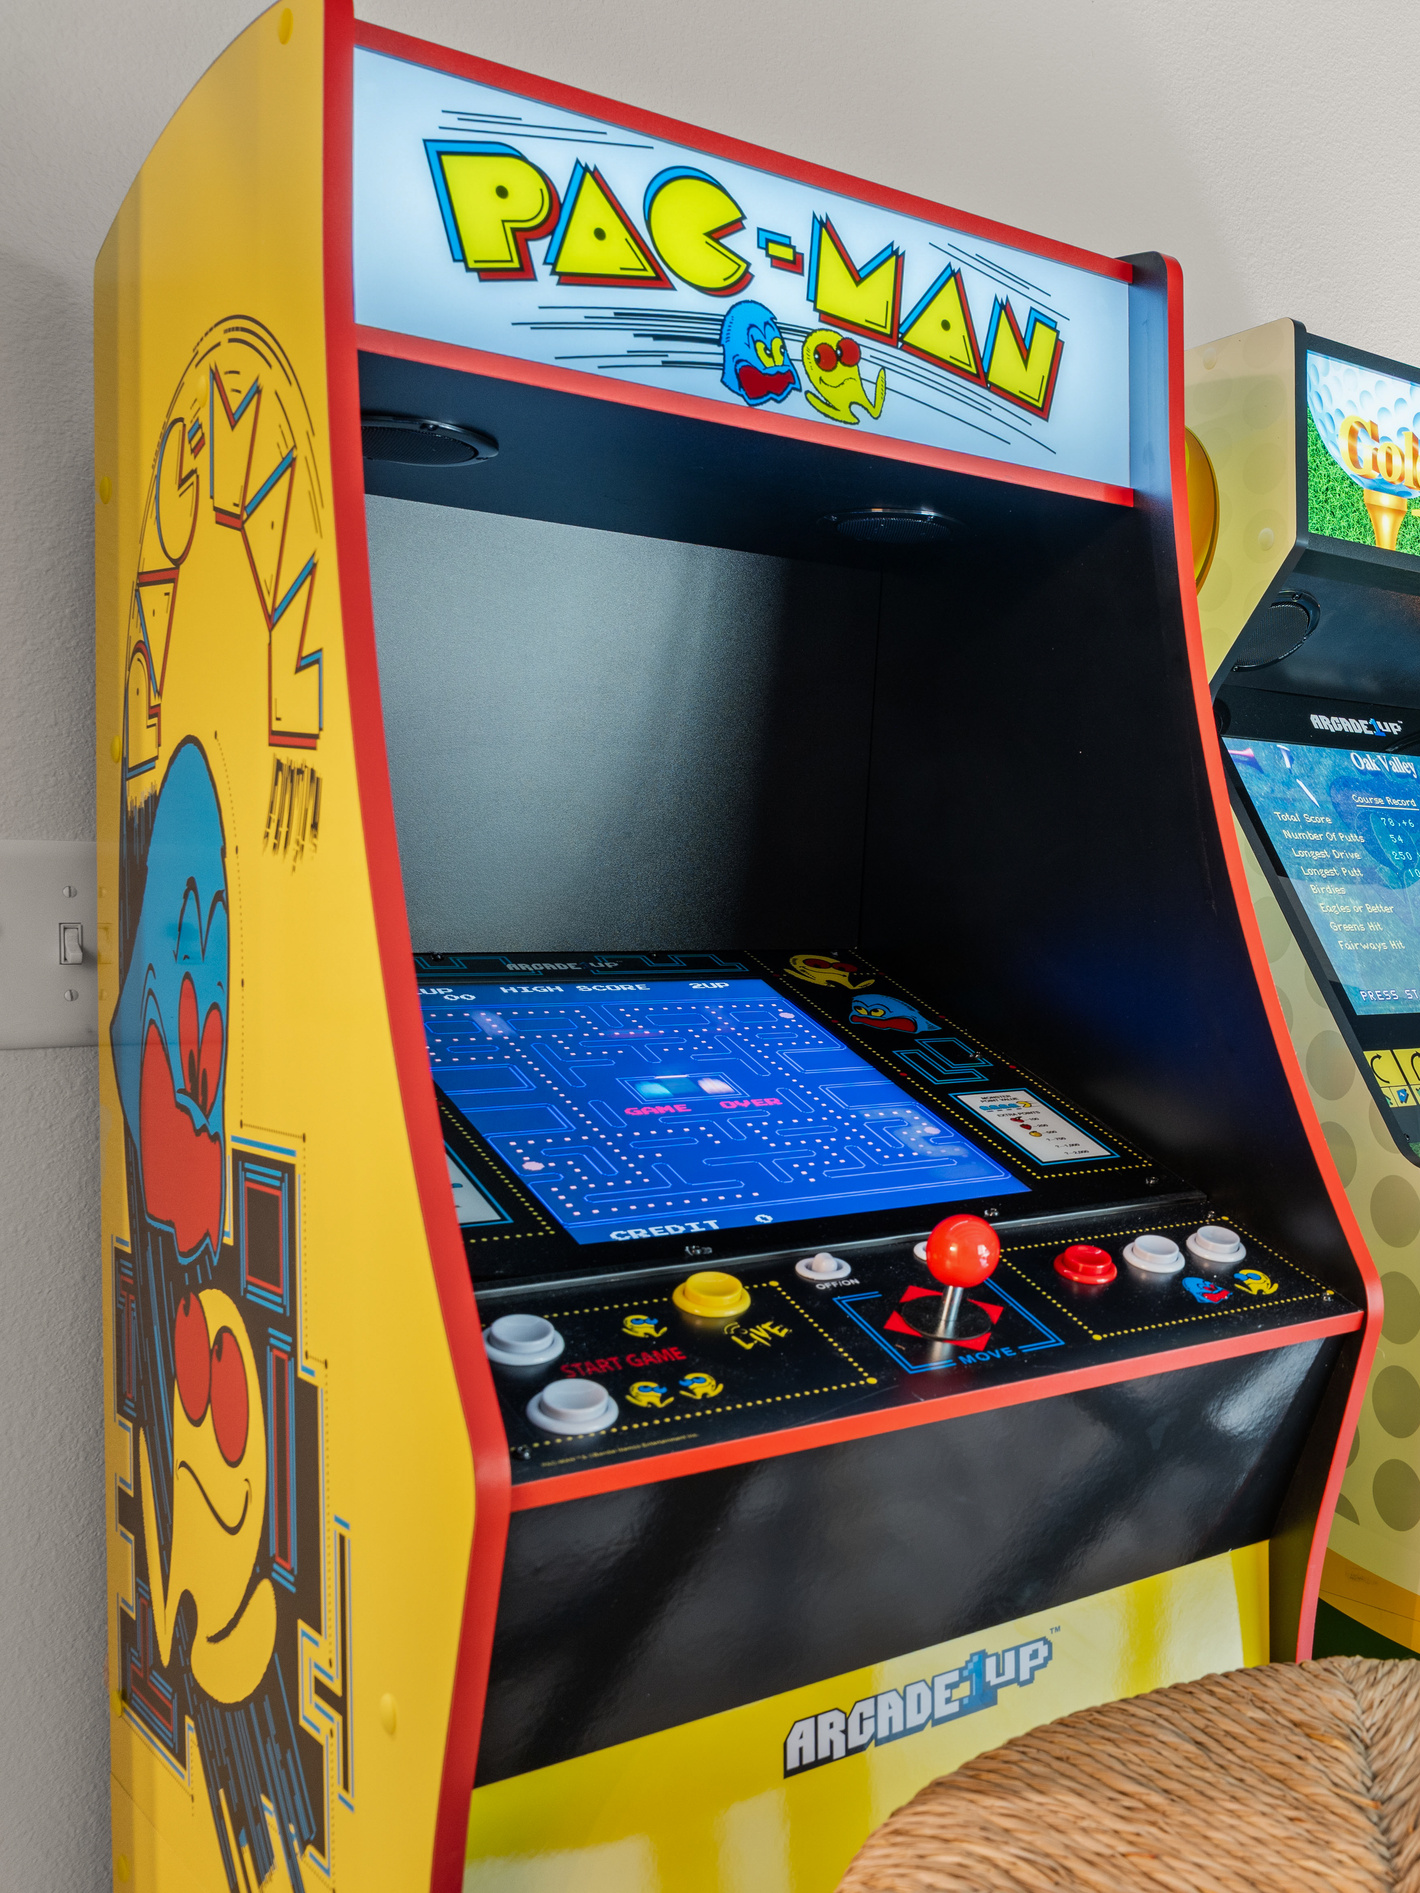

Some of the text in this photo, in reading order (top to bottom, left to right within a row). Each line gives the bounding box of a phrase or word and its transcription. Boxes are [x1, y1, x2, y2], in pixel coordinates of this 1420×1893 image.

[424, 139, 1063, 421] PAC-MAN
[1350, 752, 1417, 779] Oak Valley
[1351, 794, 1417, 807] Course Record
[1274, 811, 1332, 824] Total Score
[1283, 829, 1365, 843] Number Of Putts
[1389, 834, 1403, 844] 54
[1292, 848, 1361, 860] Longest Drive
[1392, 851, 1412, 861] 250
[1301, 866, 1364, 878] Longest Putt
[1408, 868, 1420, 878] 10
[1309, 884, 1346, 895] Birdies
[1319, 902, 1394, 914] Eagles or Better
[1329, 921, 1383, 932] Greens Hit
[1337, 940, 1406, 952] Fairways Hit
[500, 981, 729, 994] HIGH SCORE 2UP
[444, 993, 476, 1001] 00
[1360, 989, 1399, 1001] PRESS
[624, 1098, 783, 1116] GAME OVER
[609, 1219, 720, 1241] CREDIT
[815, 1278, 860, 1290] OFF/ON
[731, 1320, 791, 1350] LIVE
[958, 1344, 1017, 1367] MOVE
[559, 1346, 687, 1379] START GAME
